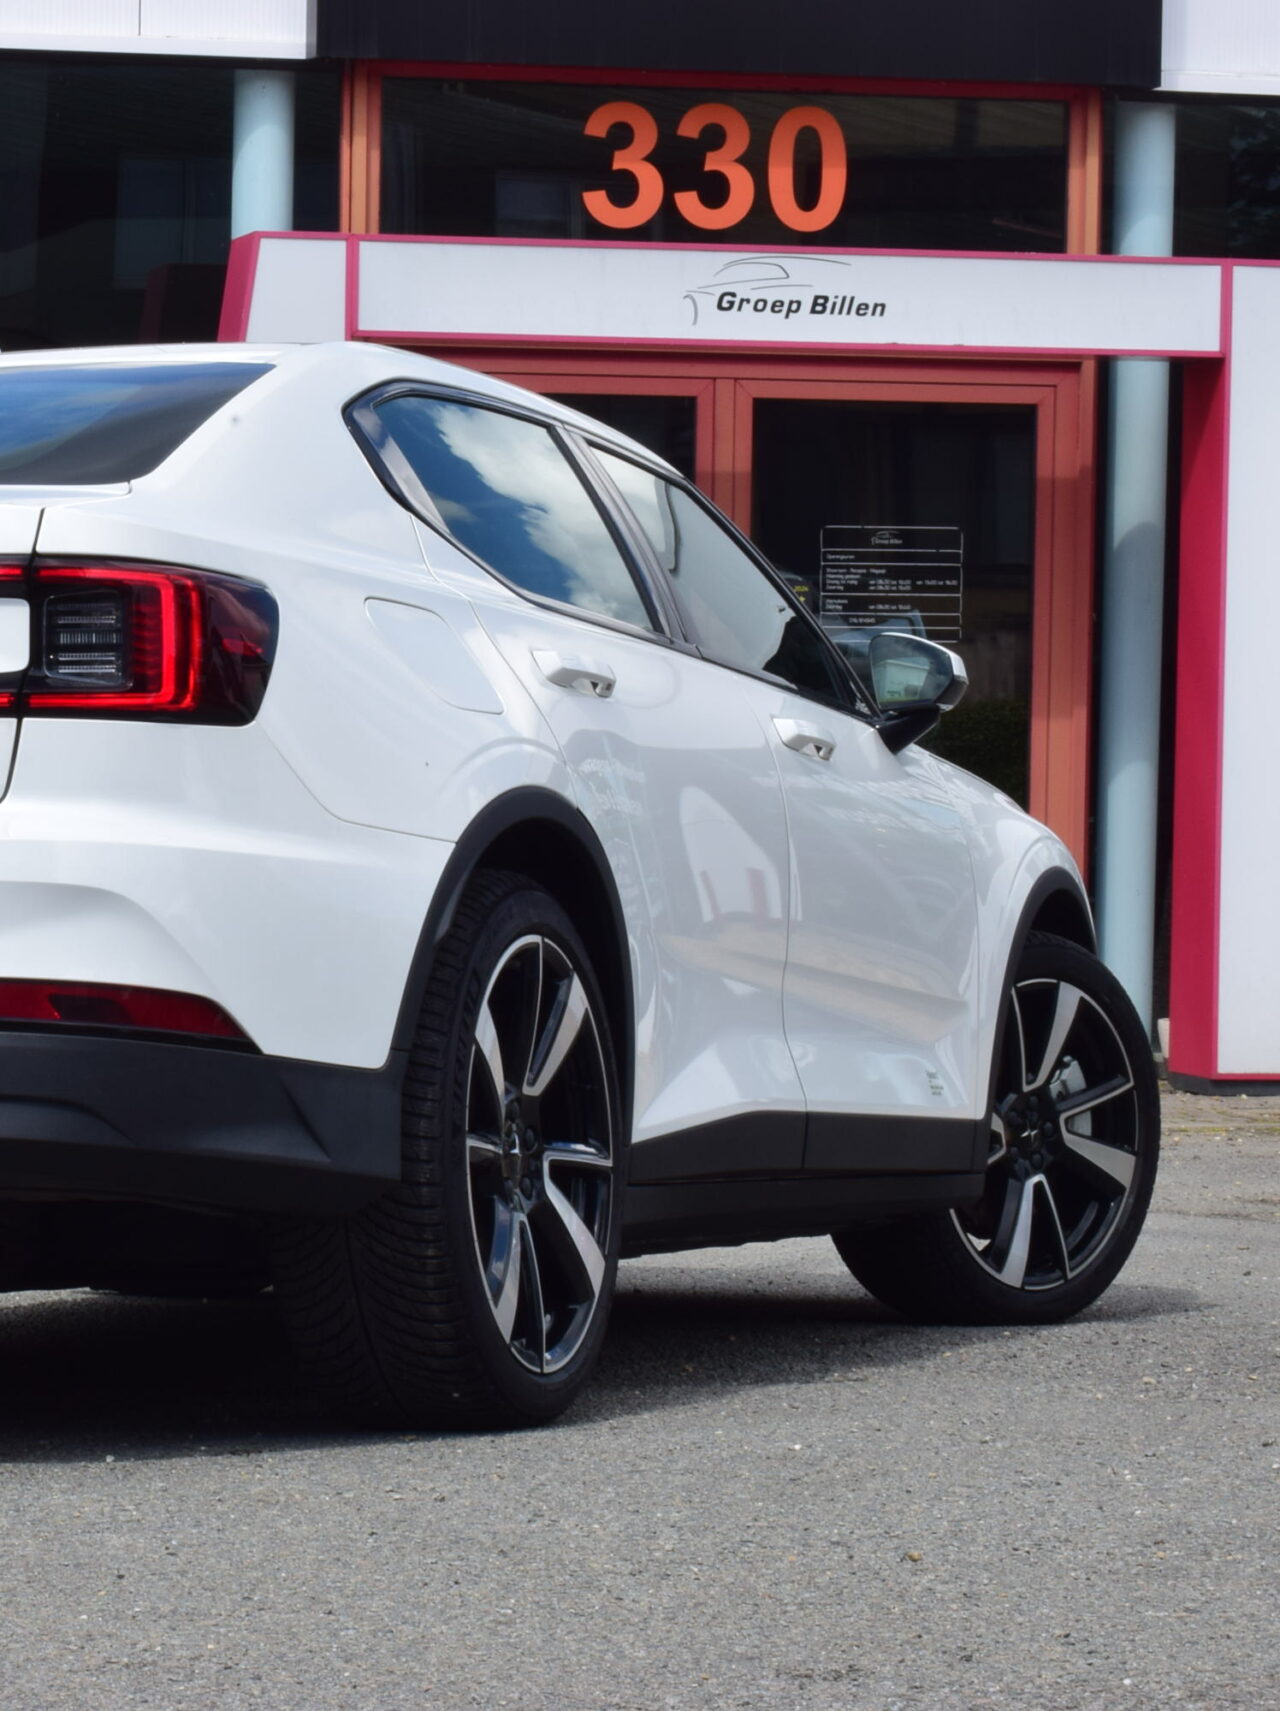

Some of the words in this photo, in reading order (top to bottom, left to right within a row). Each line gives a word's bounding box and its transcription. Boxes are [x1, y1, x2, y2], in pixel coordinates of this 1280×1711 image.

[582, 101, 848, 232] 330
[715, 291, 802, 319] Groep
[808, 294, 887, 317] Billen
